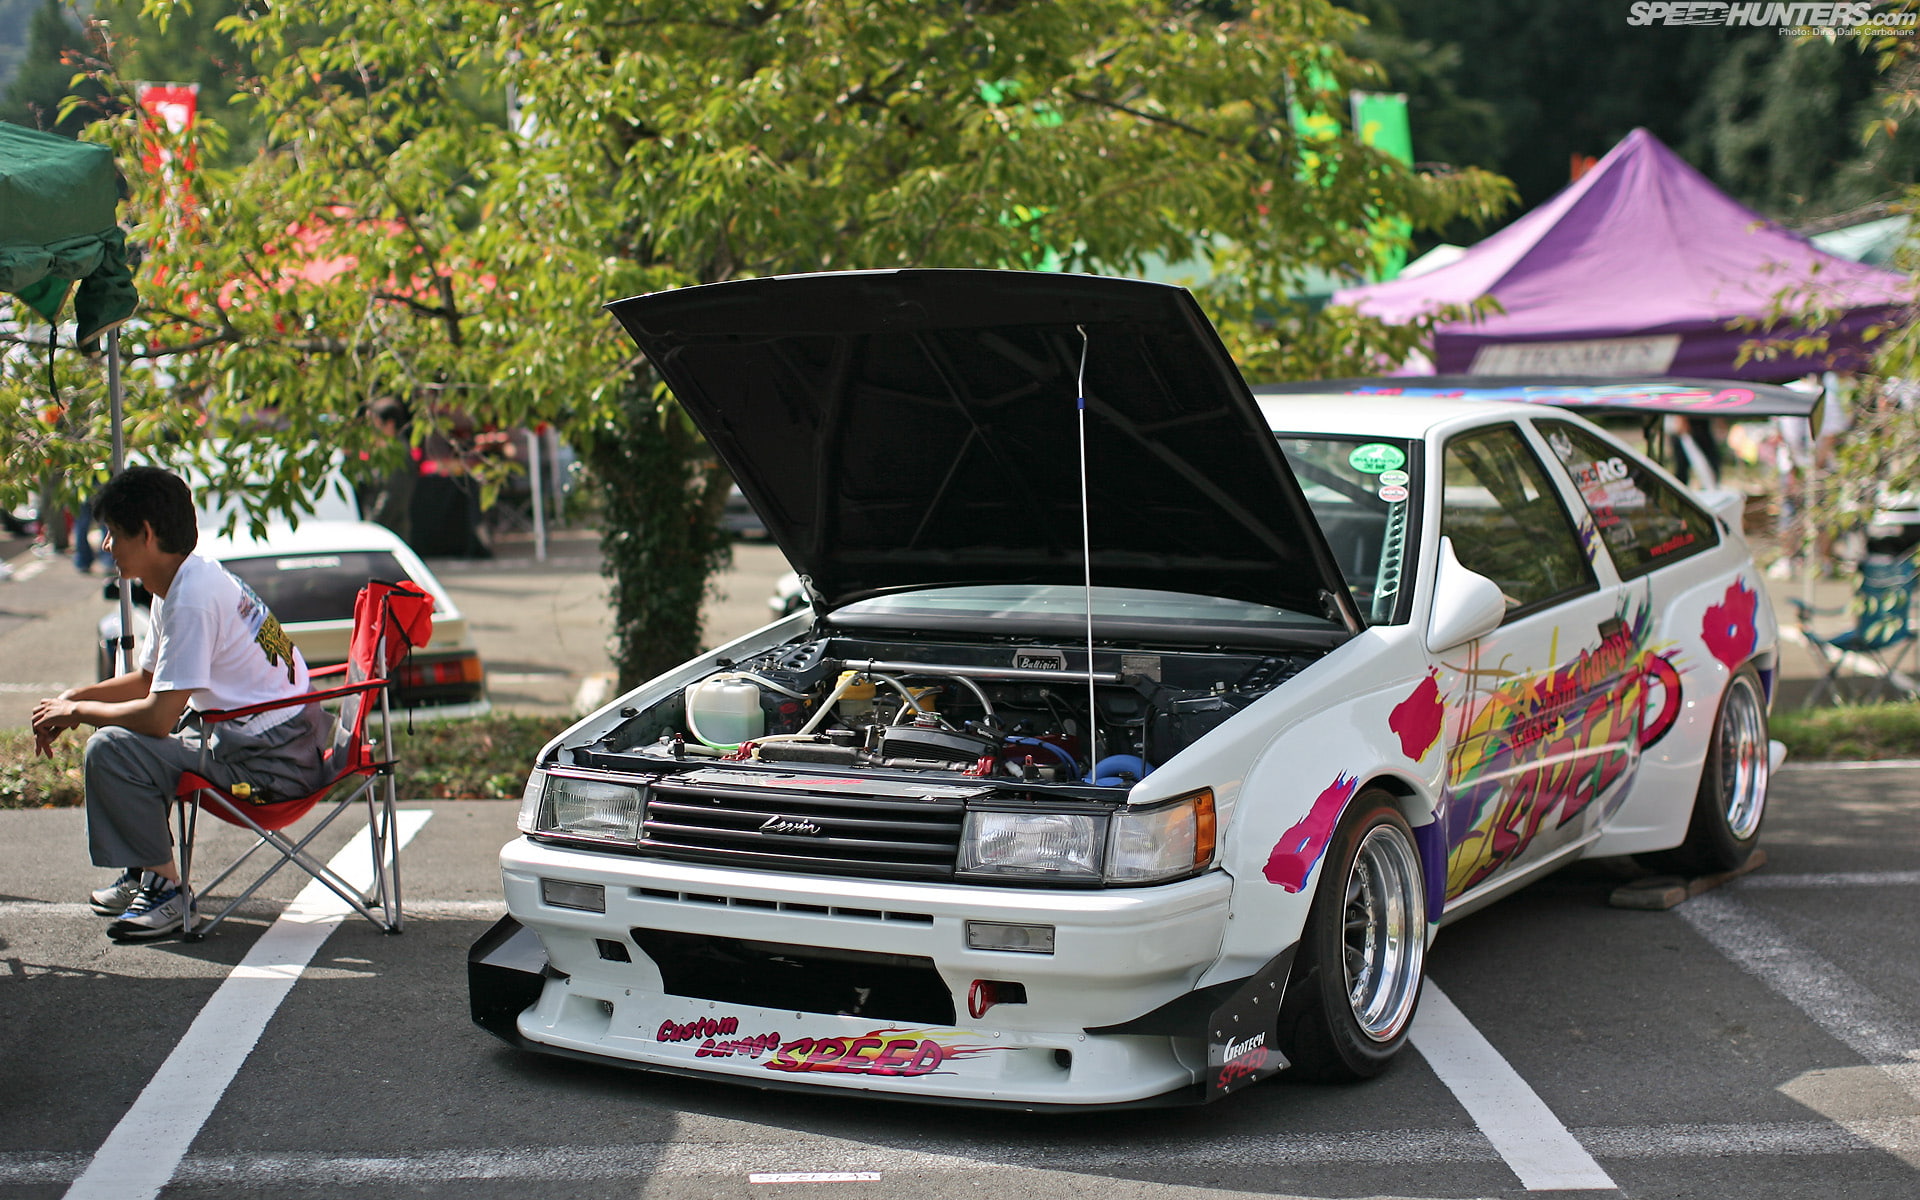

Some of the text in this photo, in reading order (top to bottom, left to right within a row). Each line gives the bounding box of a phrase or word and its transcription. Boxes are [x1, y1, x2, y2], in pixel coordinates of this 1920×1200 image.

[657, 1016, 739, 1042] Custom
[695, 1032, 781, 1059] Garage
[761, 1037, 945, 1076] SPEED
